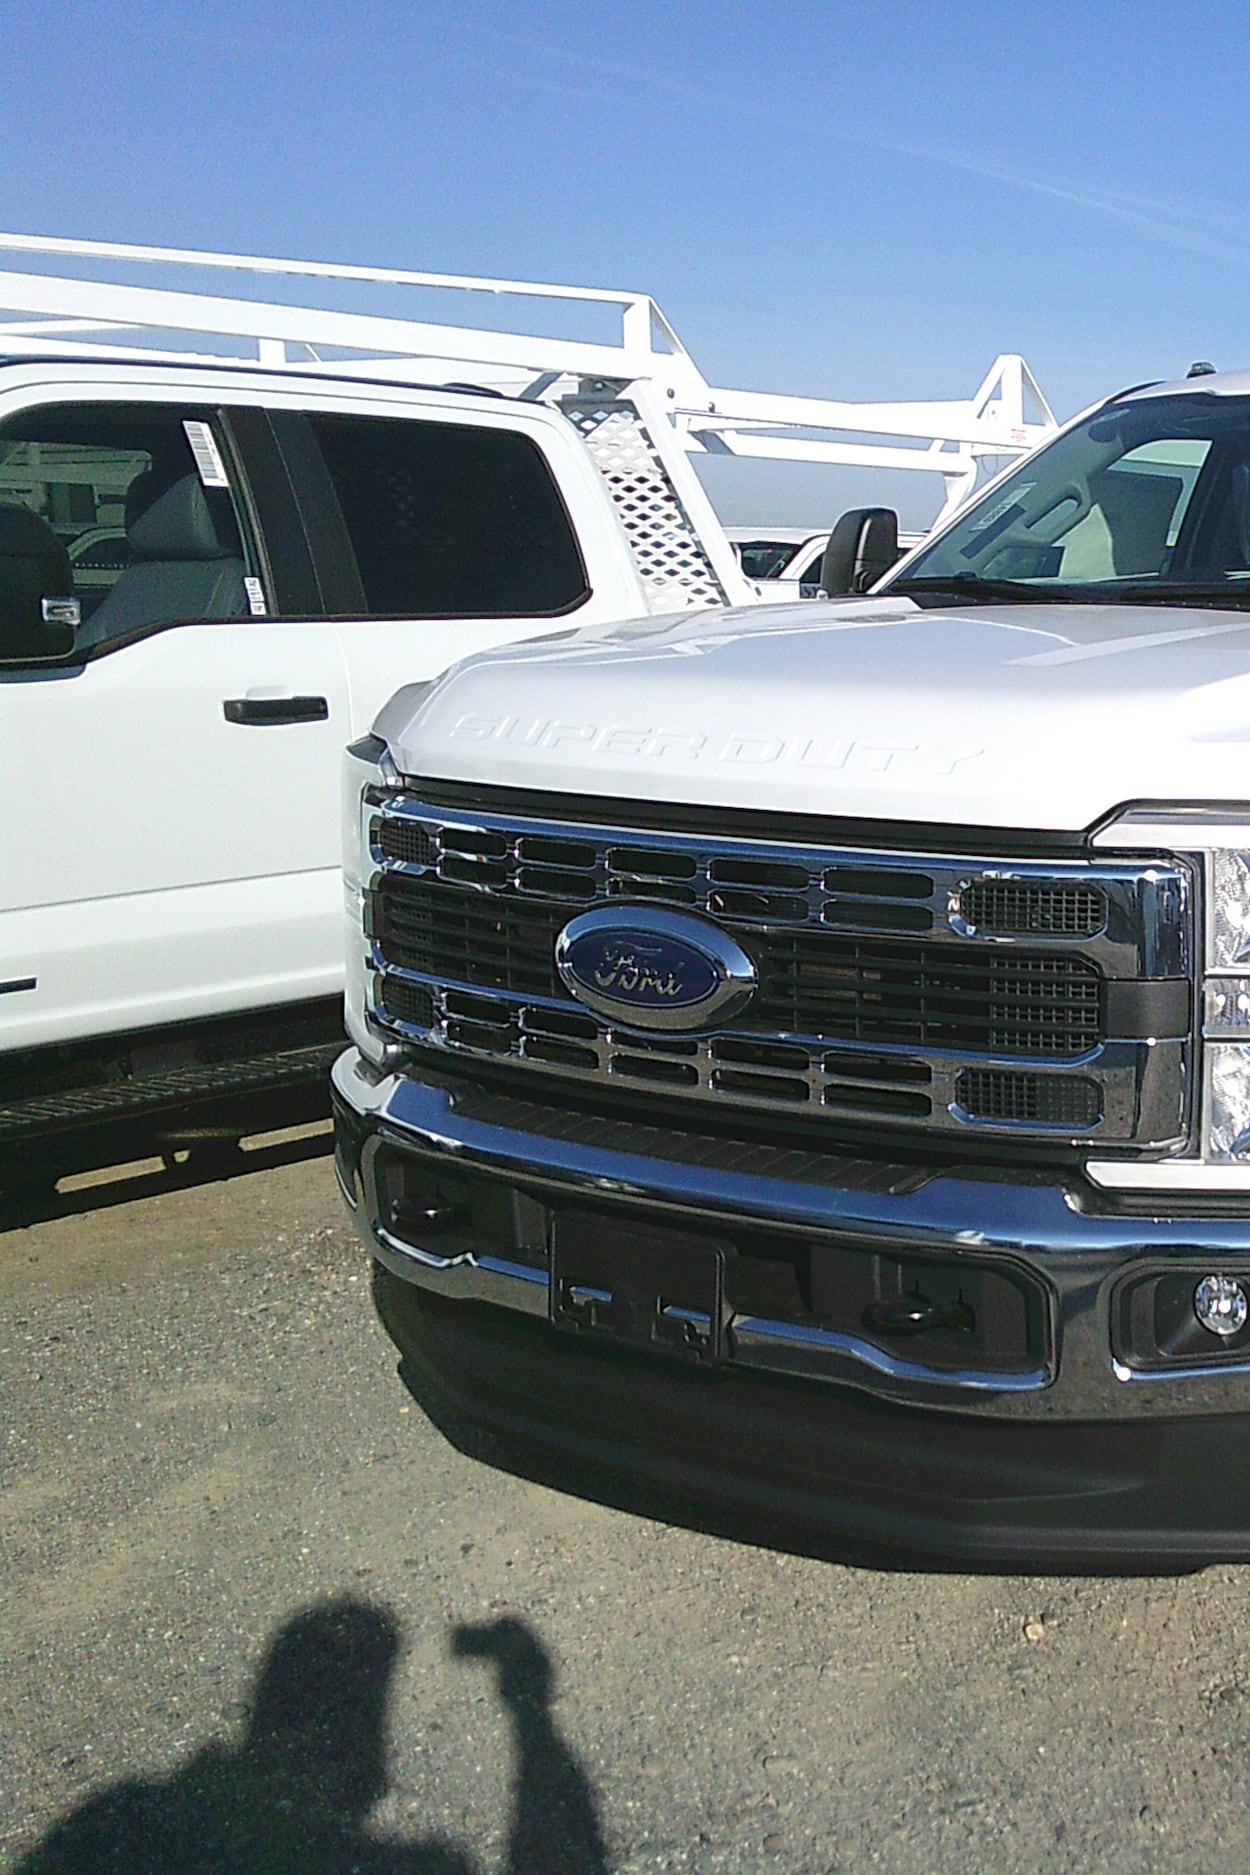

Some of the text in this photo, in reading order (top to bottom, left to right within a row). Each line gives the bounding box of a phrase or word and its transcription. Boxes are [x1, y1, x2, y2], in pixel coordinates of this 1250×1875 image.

[448, 711, 985, 776] SUPER DUTY
[593, 940, 685, 996] Ford
